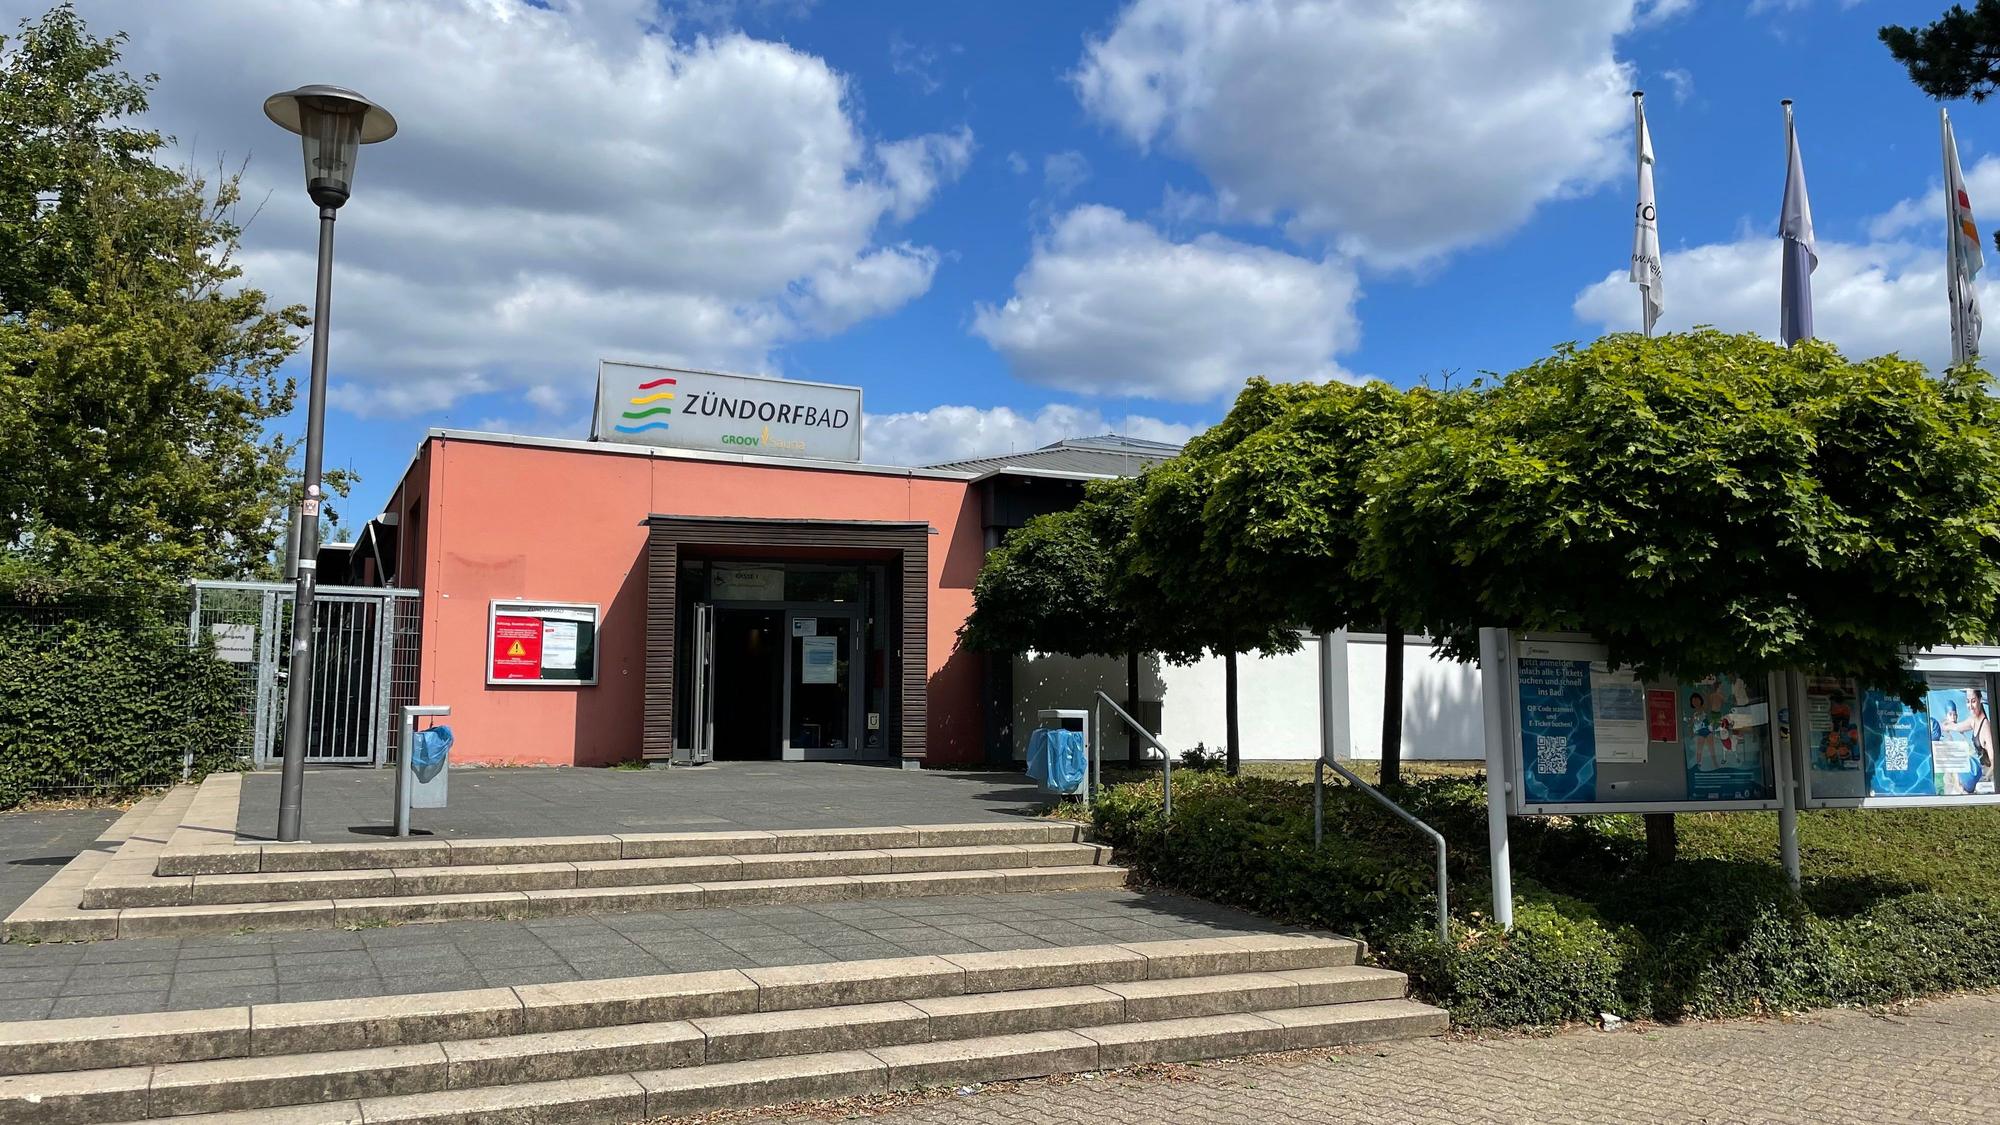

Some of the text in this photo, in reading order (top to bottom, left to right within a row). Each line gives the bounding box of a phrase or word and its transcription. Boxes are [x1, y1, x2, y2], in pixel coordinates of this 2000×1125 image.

[682, 391, 849, 429] ZÜNDORFBAD
[721, 435, 760, 448] GROOV
[1545, 678, 1559, 686] und
[1559, 678, 1582, 687] schnell
[1538, 687, 1564, 697] ins Bad!
